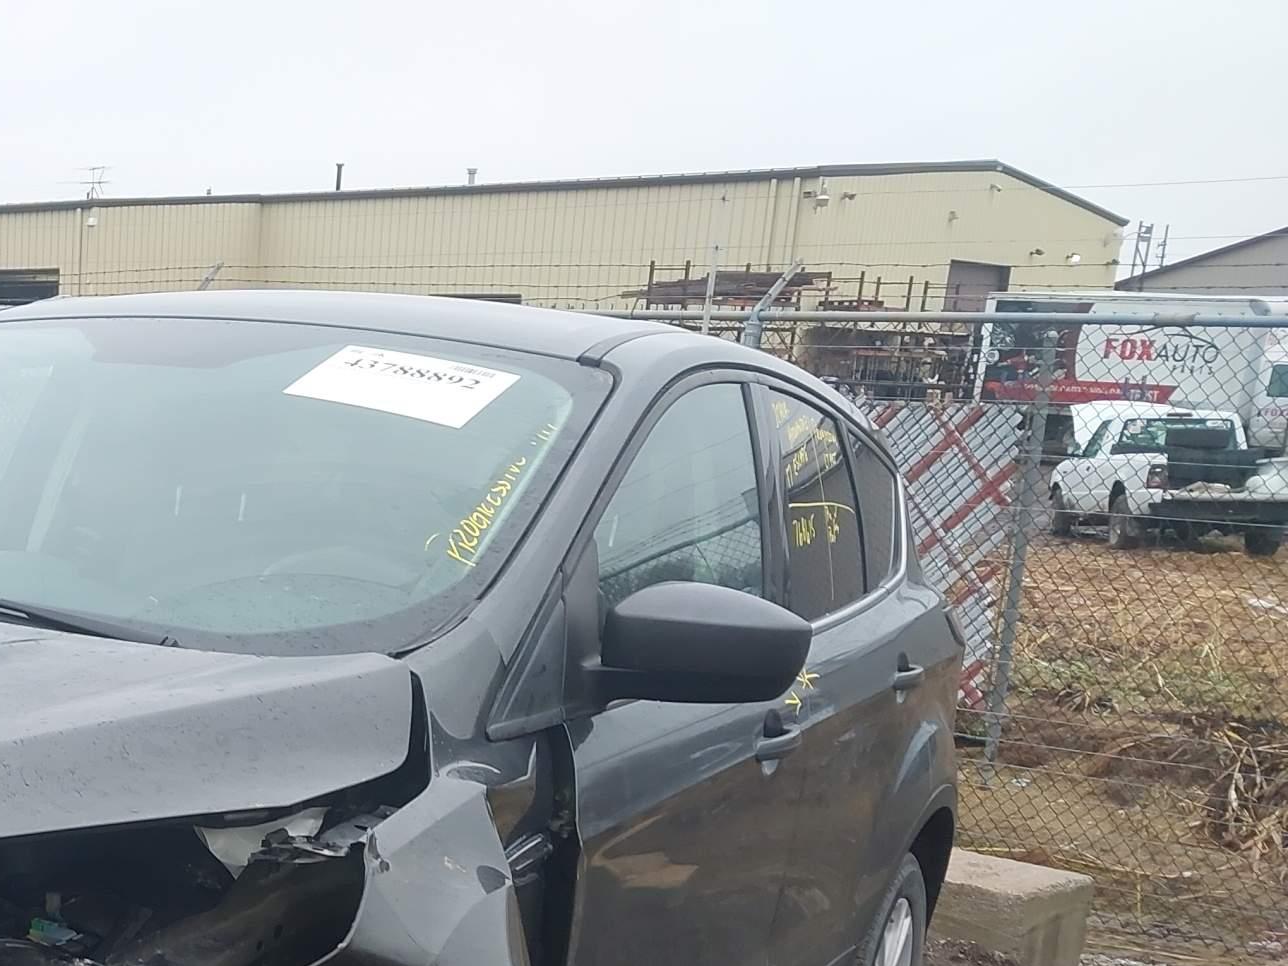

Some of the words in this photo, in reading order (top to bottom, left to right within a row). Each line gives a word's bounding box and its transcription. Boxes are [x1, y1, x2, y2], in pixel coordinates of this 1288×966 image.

[1103, 337, 1156, 361] FOX
[1155, 344, 1219, 364] AUTO
[343, 357, 482, 390] 43788892
[1129, 389, 1160, 402] TRST
